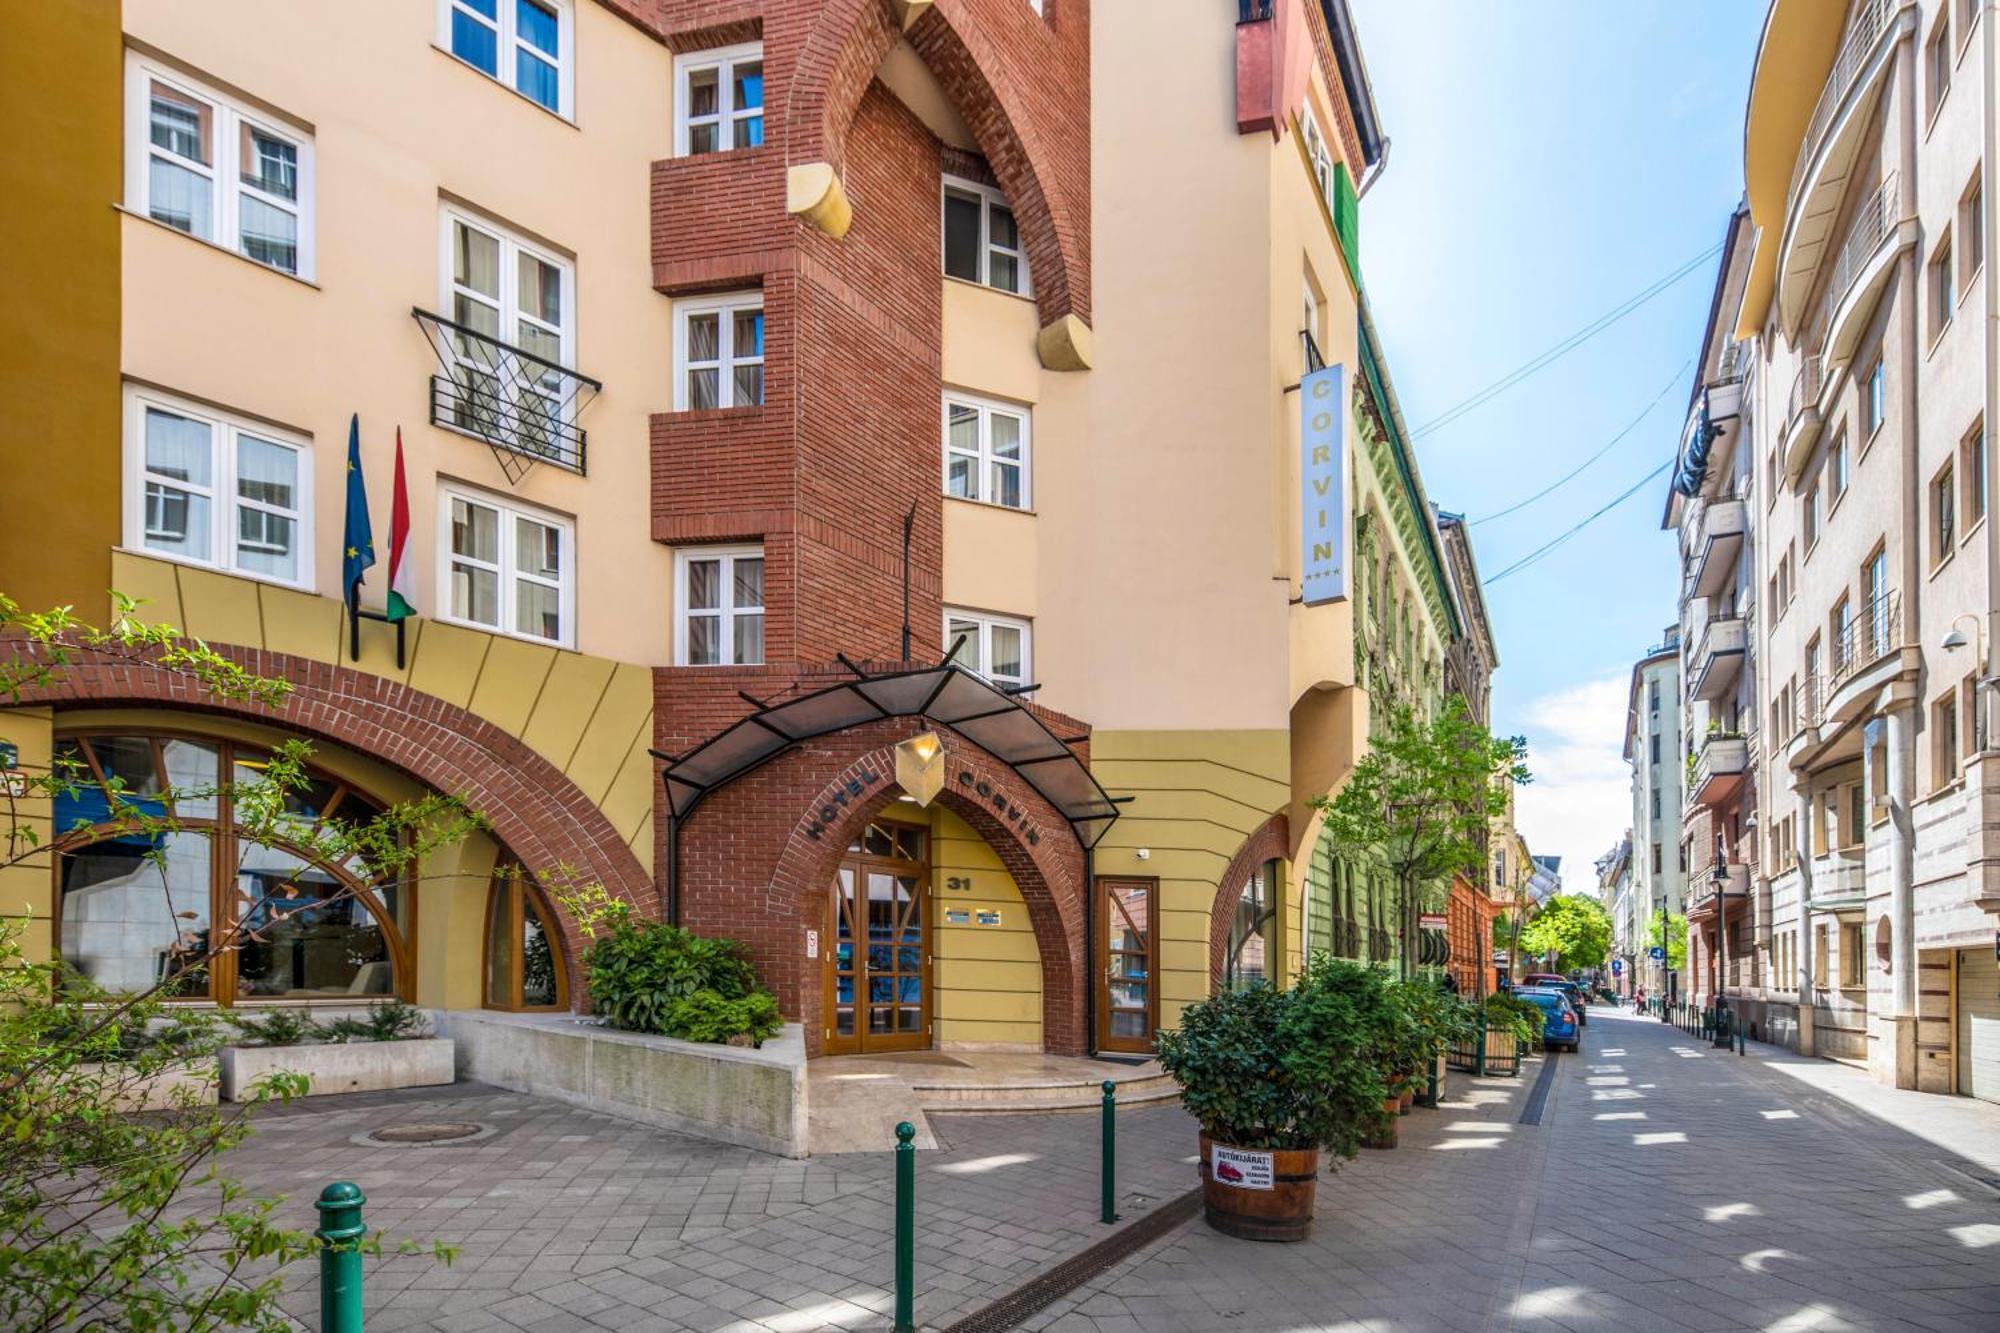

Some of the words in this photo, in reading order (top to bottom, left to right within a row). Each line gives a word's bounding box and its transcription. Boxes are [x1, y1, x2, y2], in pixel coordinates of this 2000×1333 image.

[1311, 380, 1332, 562] CORVIN
[806, 771, 880, 840] HOTEL
[959, 771, 1040, 846] CORVIN
[947, 877, 971, 890] 31
